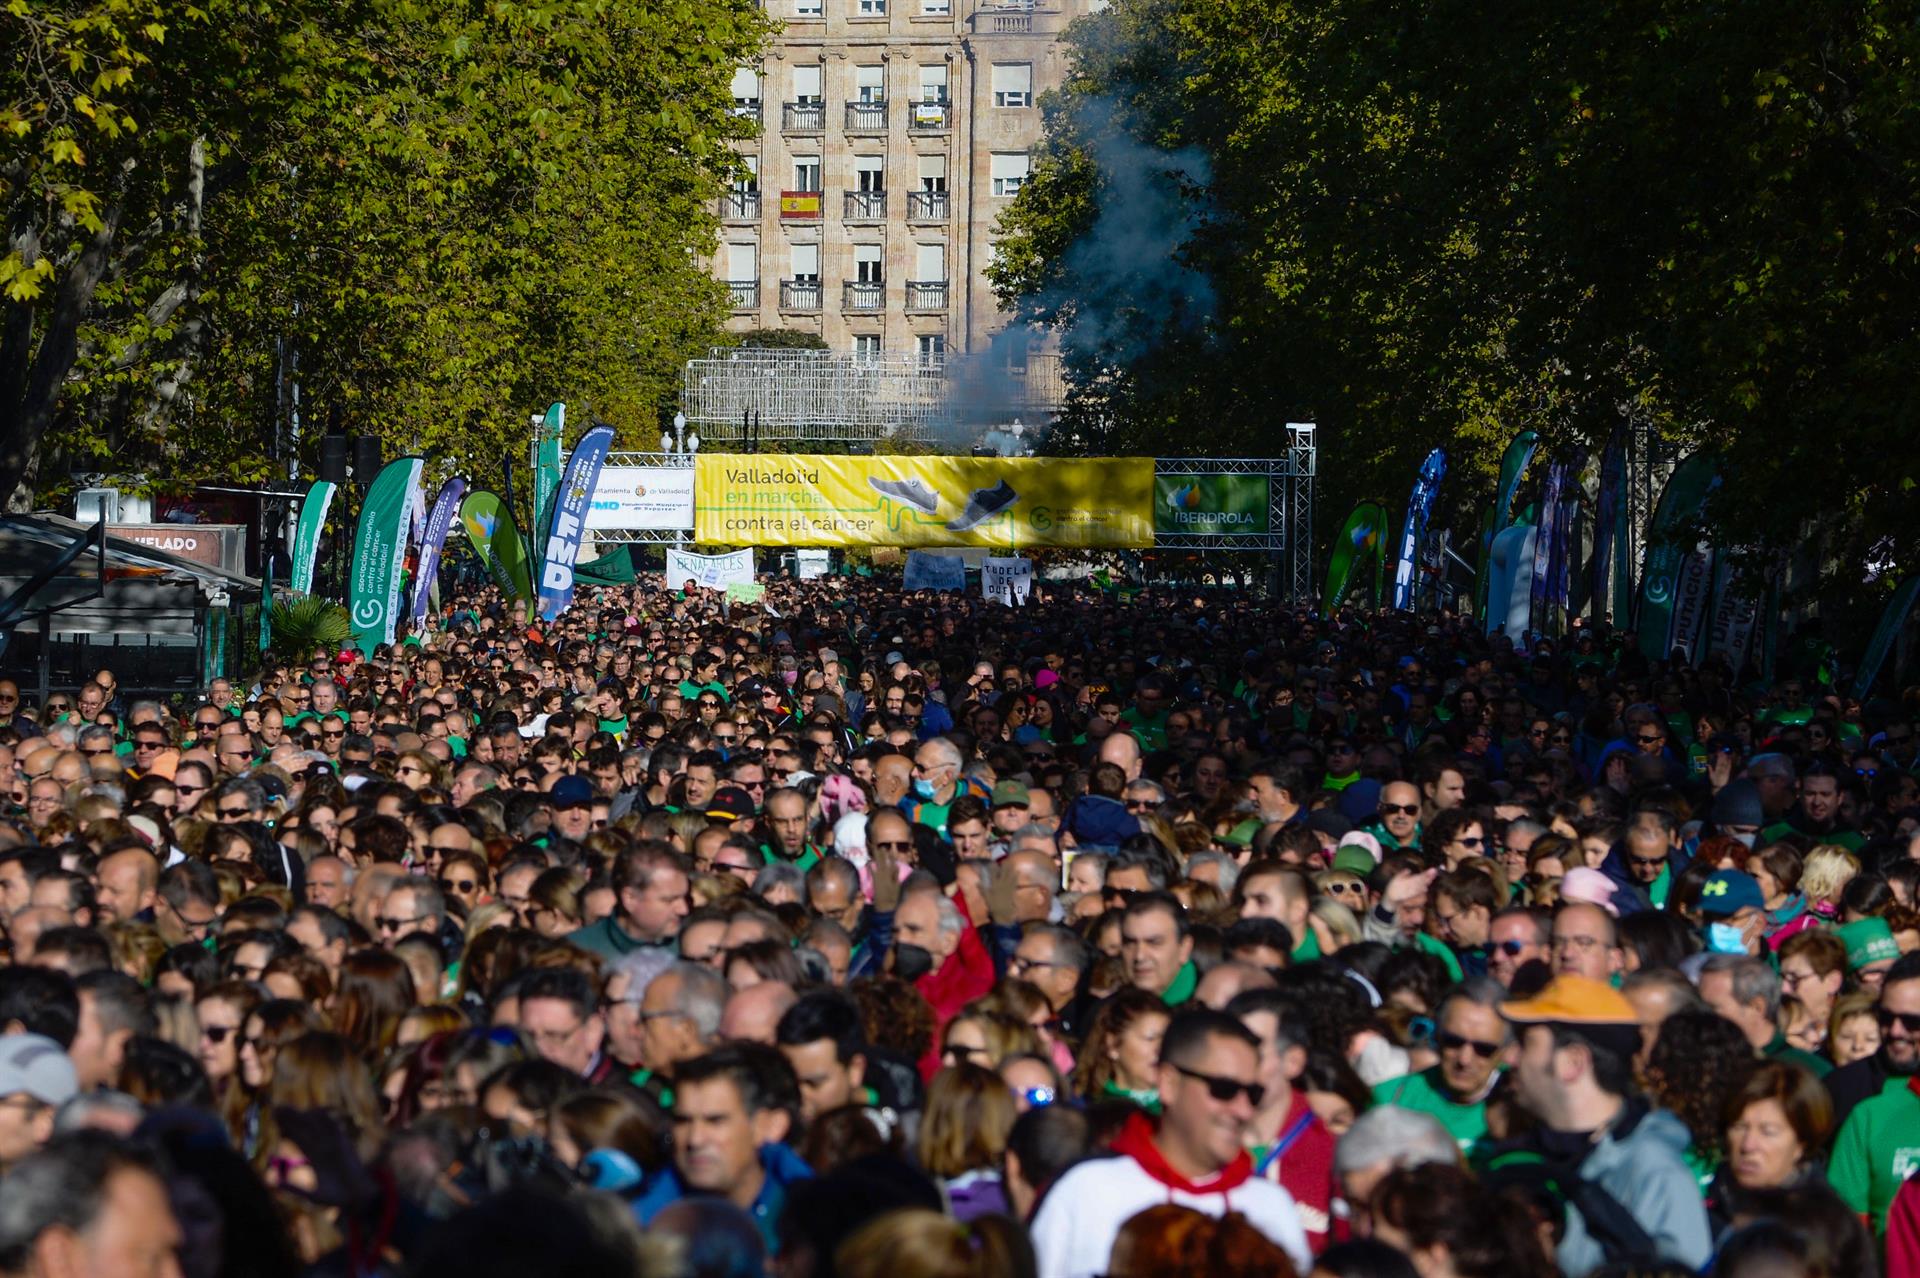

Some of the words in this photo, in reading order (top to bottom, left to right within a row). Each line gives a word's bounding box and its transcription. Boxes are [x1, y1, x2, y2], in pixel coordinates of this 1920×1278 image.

[726, 469, 819, 485] Valladolid
[725, 491, 749, 504] en
[752, 489, 823, 504] marcha
[725, 518, 784, 531] contra
[789, 517, 808, 531] el
[811, 516, 875, 531] cáncer
[1174, 511, 1254, 525] IBERDROLA
[358, 549, 369, 593] asociación
[364, 511, 376, 549] española
[370, 557, 376, 567] el
[378, 543, 389, 583] Valladolid
[984, 565, 1027, 575] TUDELA
[367, 567, 376, 594] contra
[377, 584, 383, 595] en
[989, 585, 1023, 595] DUEO
